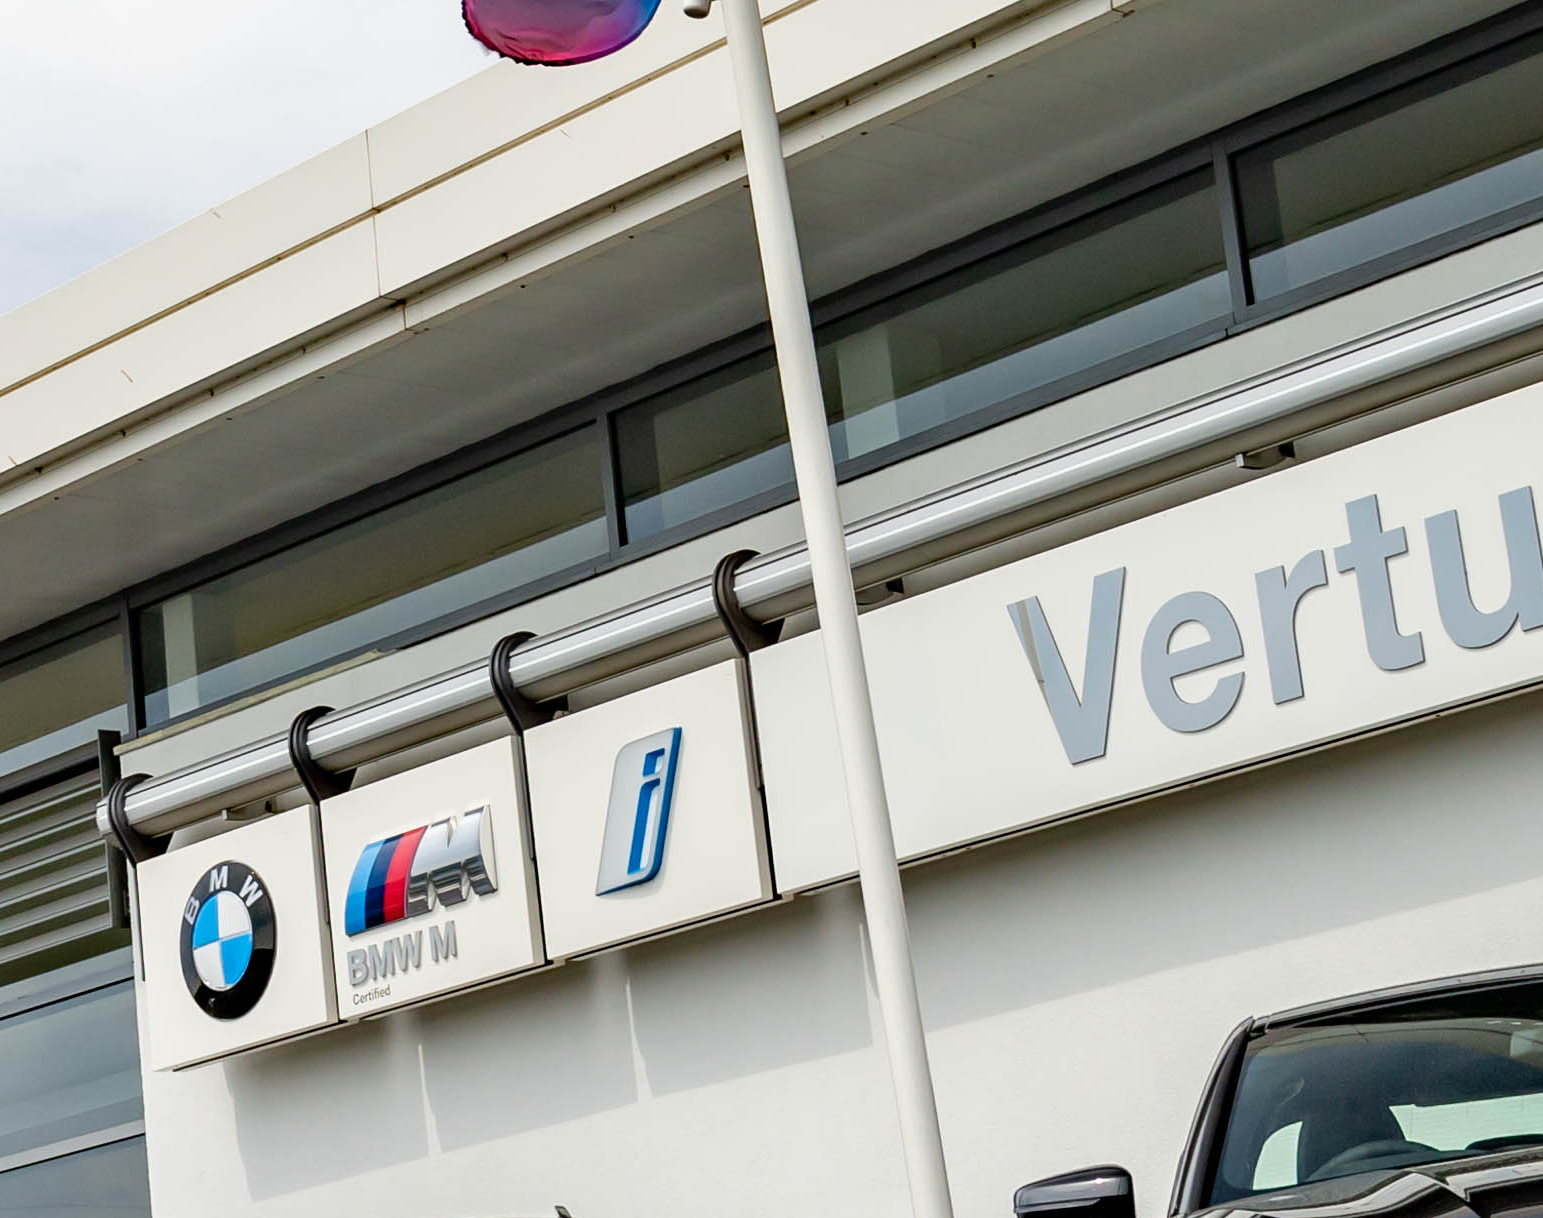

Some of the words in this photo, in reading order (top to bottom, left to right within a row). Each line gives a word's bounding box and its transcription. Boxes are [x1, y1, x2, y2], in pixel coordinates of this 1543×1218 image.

[185, 865, 263, 925] BMW
[347, 930, 423, 987] BMW
[428, 919, 459, 963] M
[353, 984, 391, 1006] Certified
